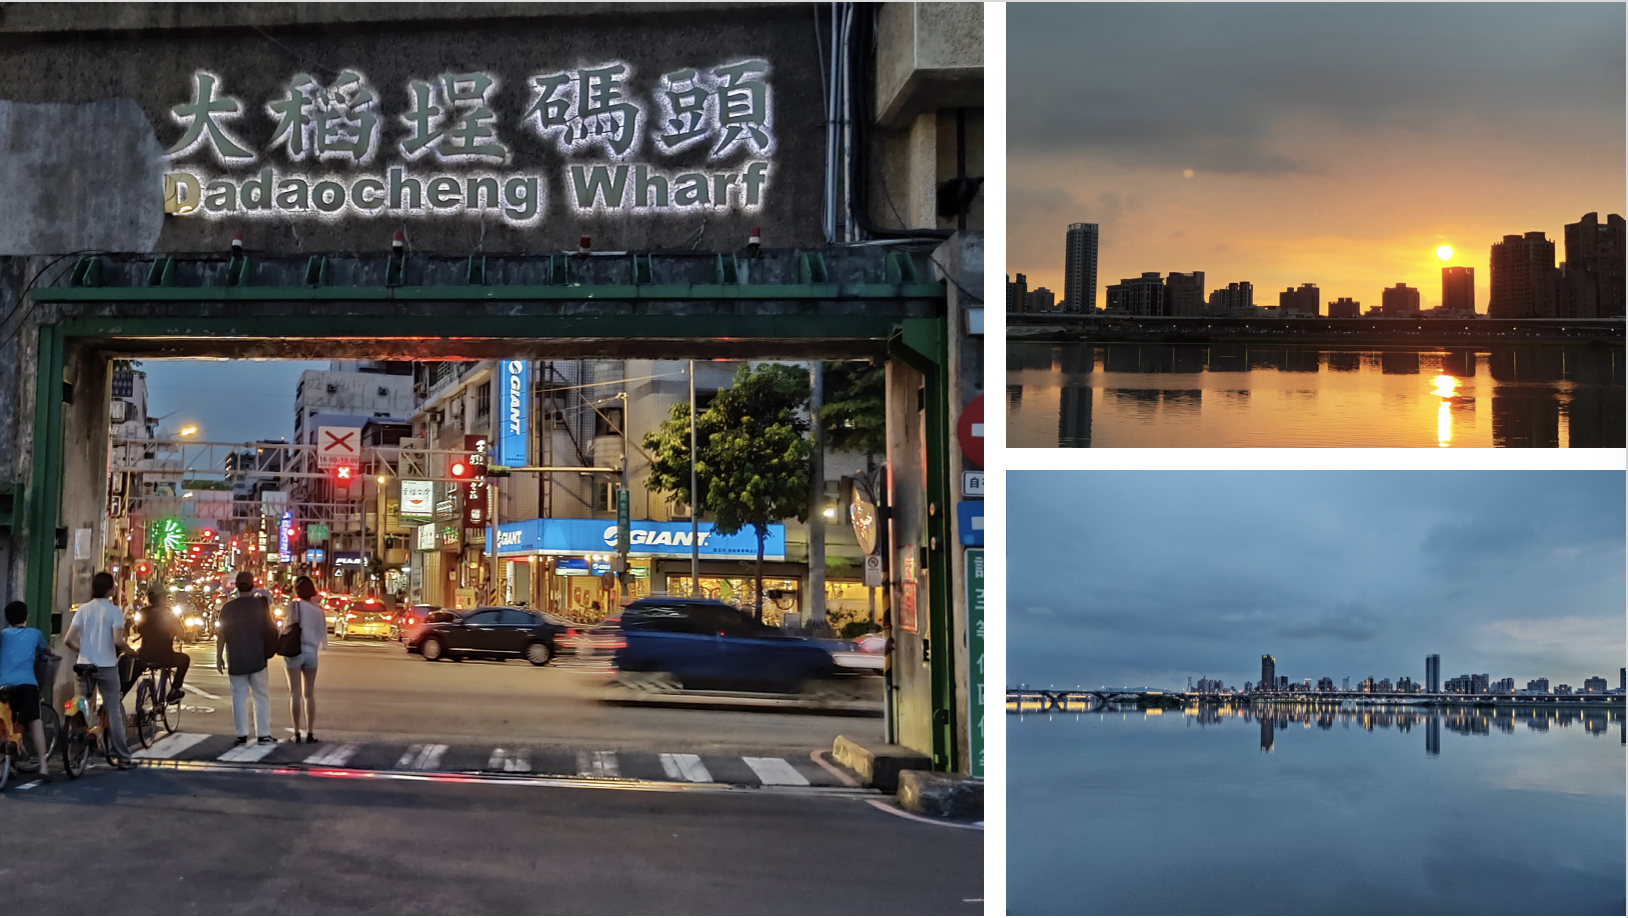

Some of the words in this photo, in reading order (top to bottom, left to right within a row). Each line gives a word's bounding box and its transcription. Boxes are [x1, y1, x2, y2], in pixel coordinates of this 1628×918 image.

[165, 58, 770, 164] 大稻埕碼頭
[164, 168, 540, 219] Dadaocheng
[571, 163, 768, 210] Wharf
[969, 477, 984, 492] 自
